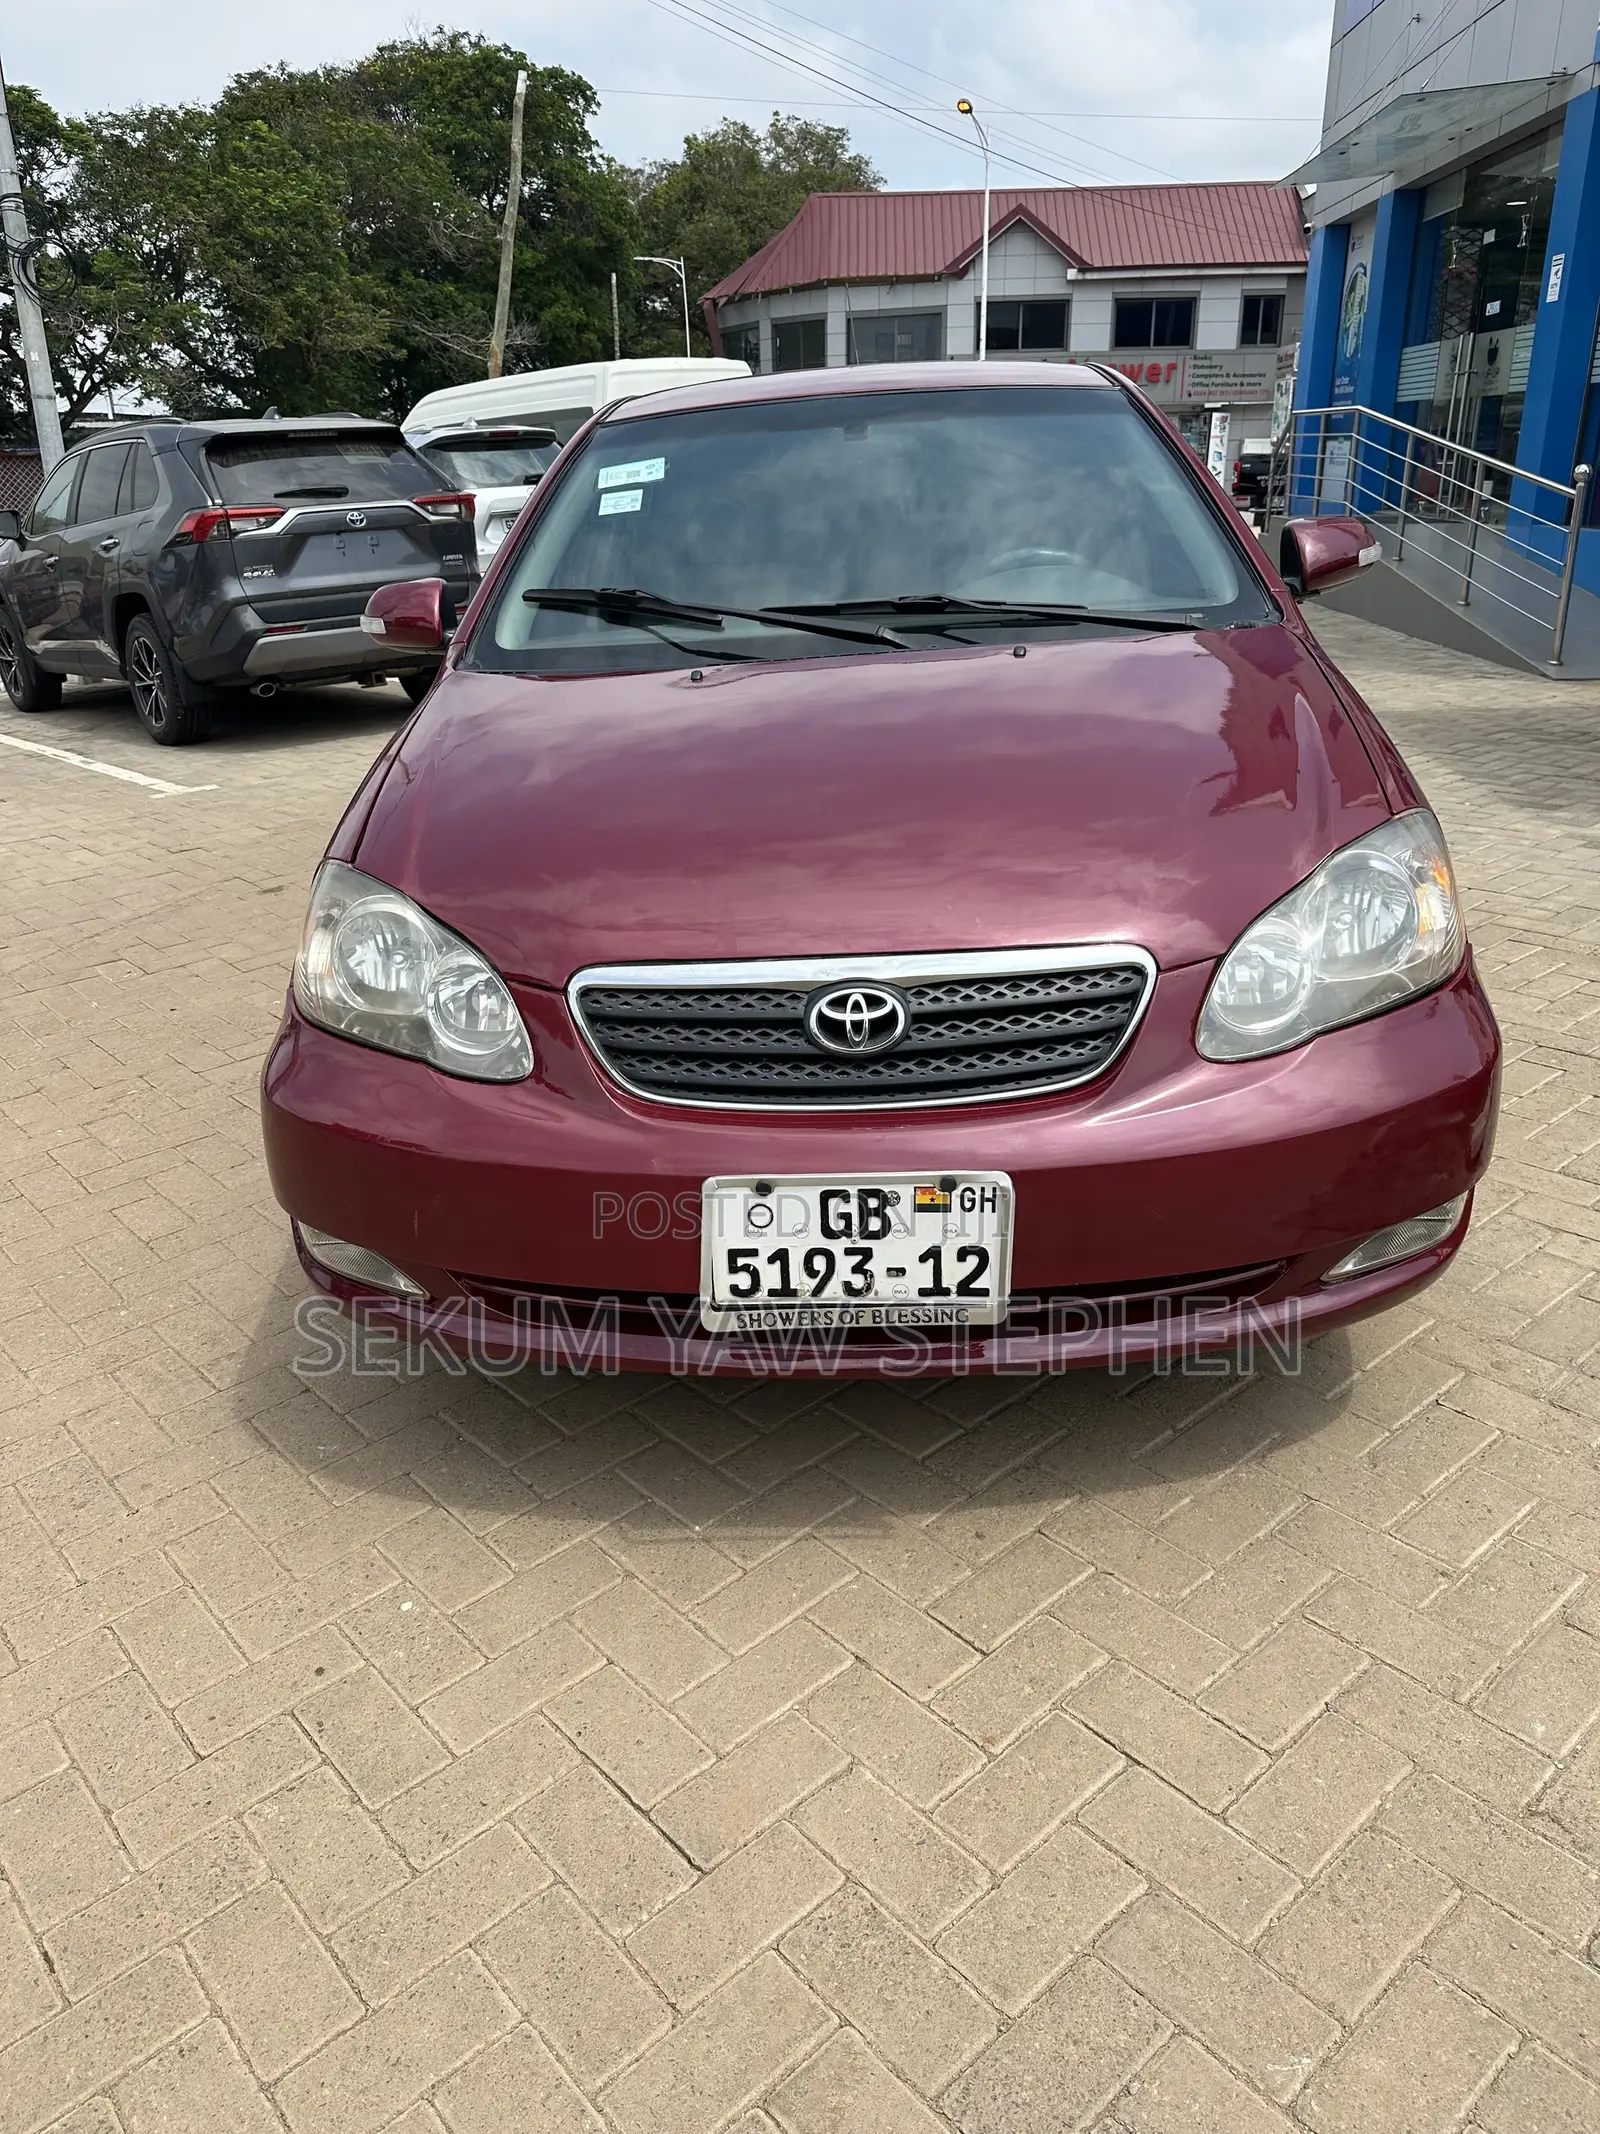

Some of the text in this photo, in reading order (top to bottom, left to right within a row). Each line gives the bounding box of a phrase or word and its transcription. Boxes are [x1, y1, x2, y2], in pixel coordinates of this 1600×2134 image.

[1106, 362, 1177, 383] wer
[819, 1186, 997, 1241] GB GH
[727, 1245, 990, 1298] 5193-12
[736, 1307, 969, 1329] SHOWERS OF BLESSING
